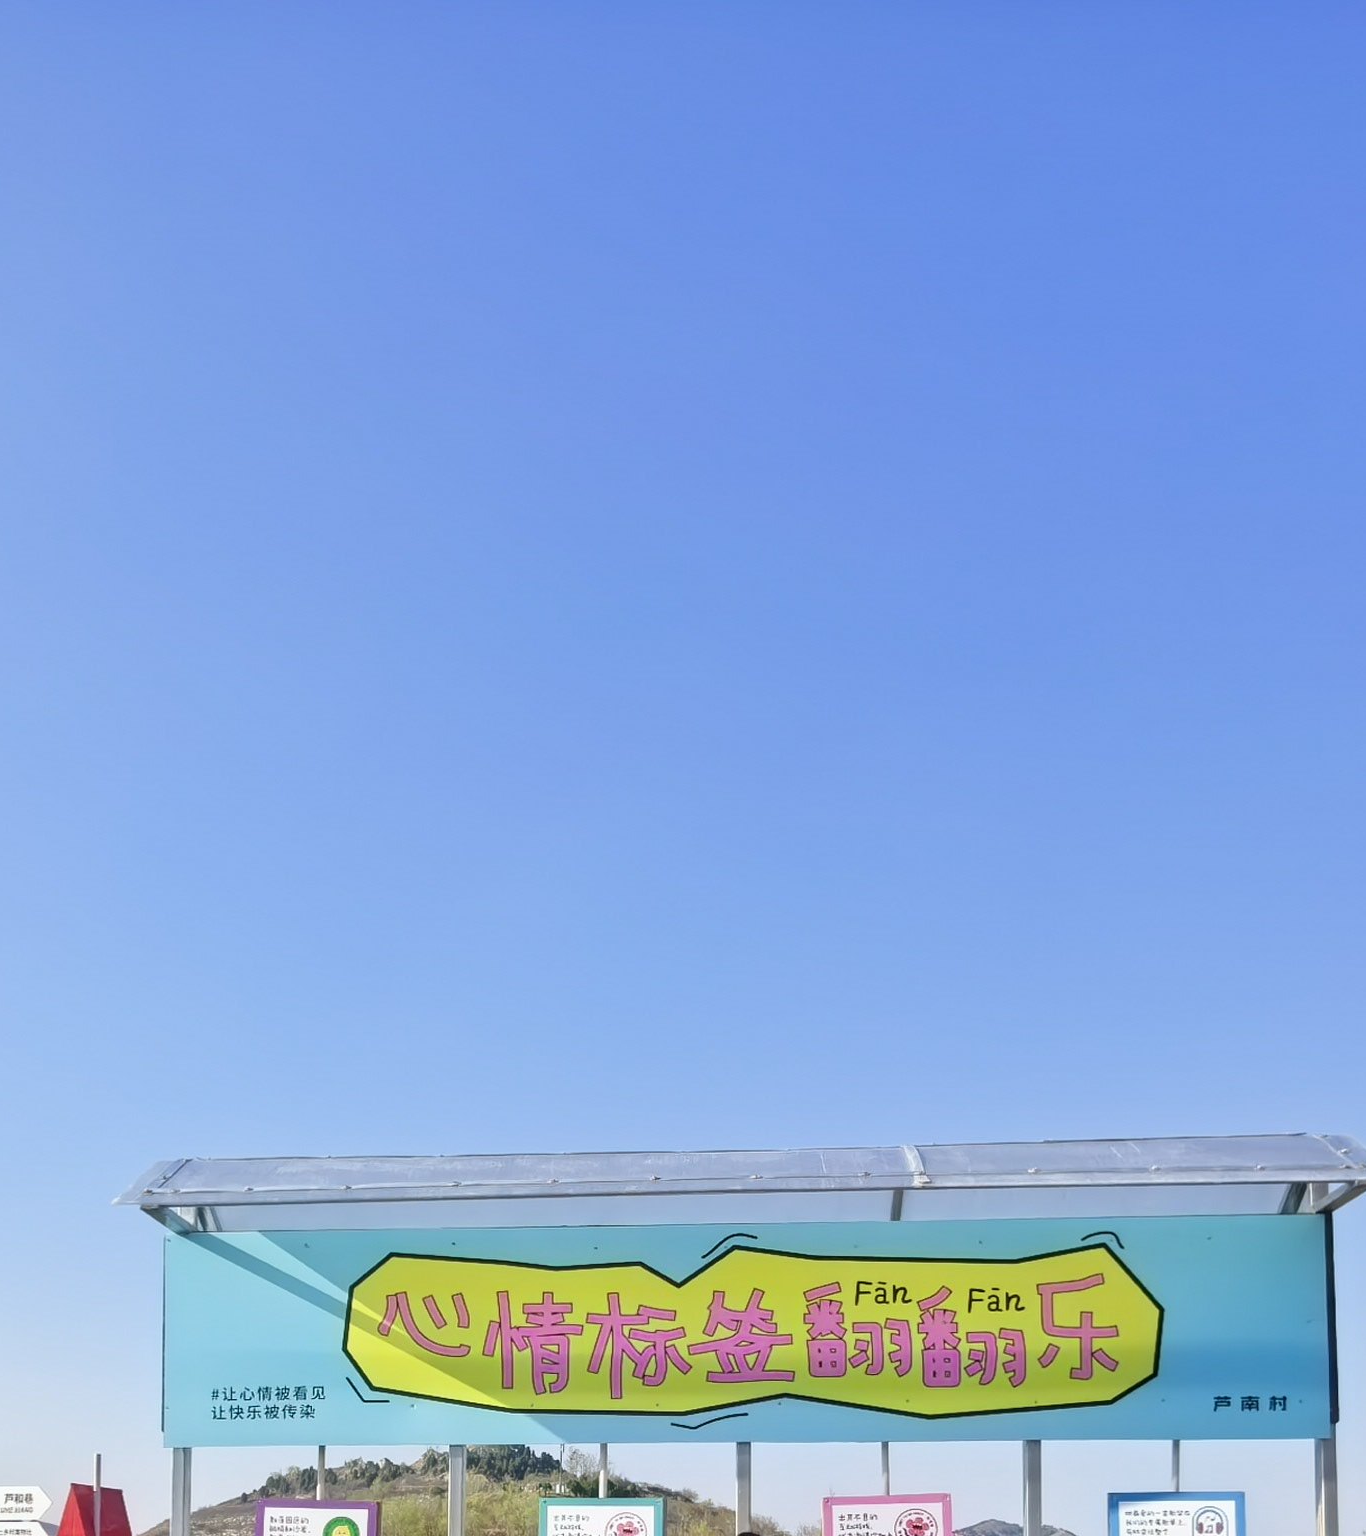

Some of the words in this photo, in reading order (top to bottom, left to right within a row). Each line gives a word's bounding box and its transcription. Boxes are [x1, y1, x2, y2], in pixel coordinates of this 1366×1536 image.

[854, 1281, 912, 1306] Fān
[968, 1287, 1026, 1313] Fān
[378, 1273, 1120, 1399] 心情标签翻翻乐
[210, 1386, 326, 1401] #让心情被看见
[211, 1404, 316, 1420] 让快乐被传染
[1213, 1395, 1288, 1412] 芦南村
